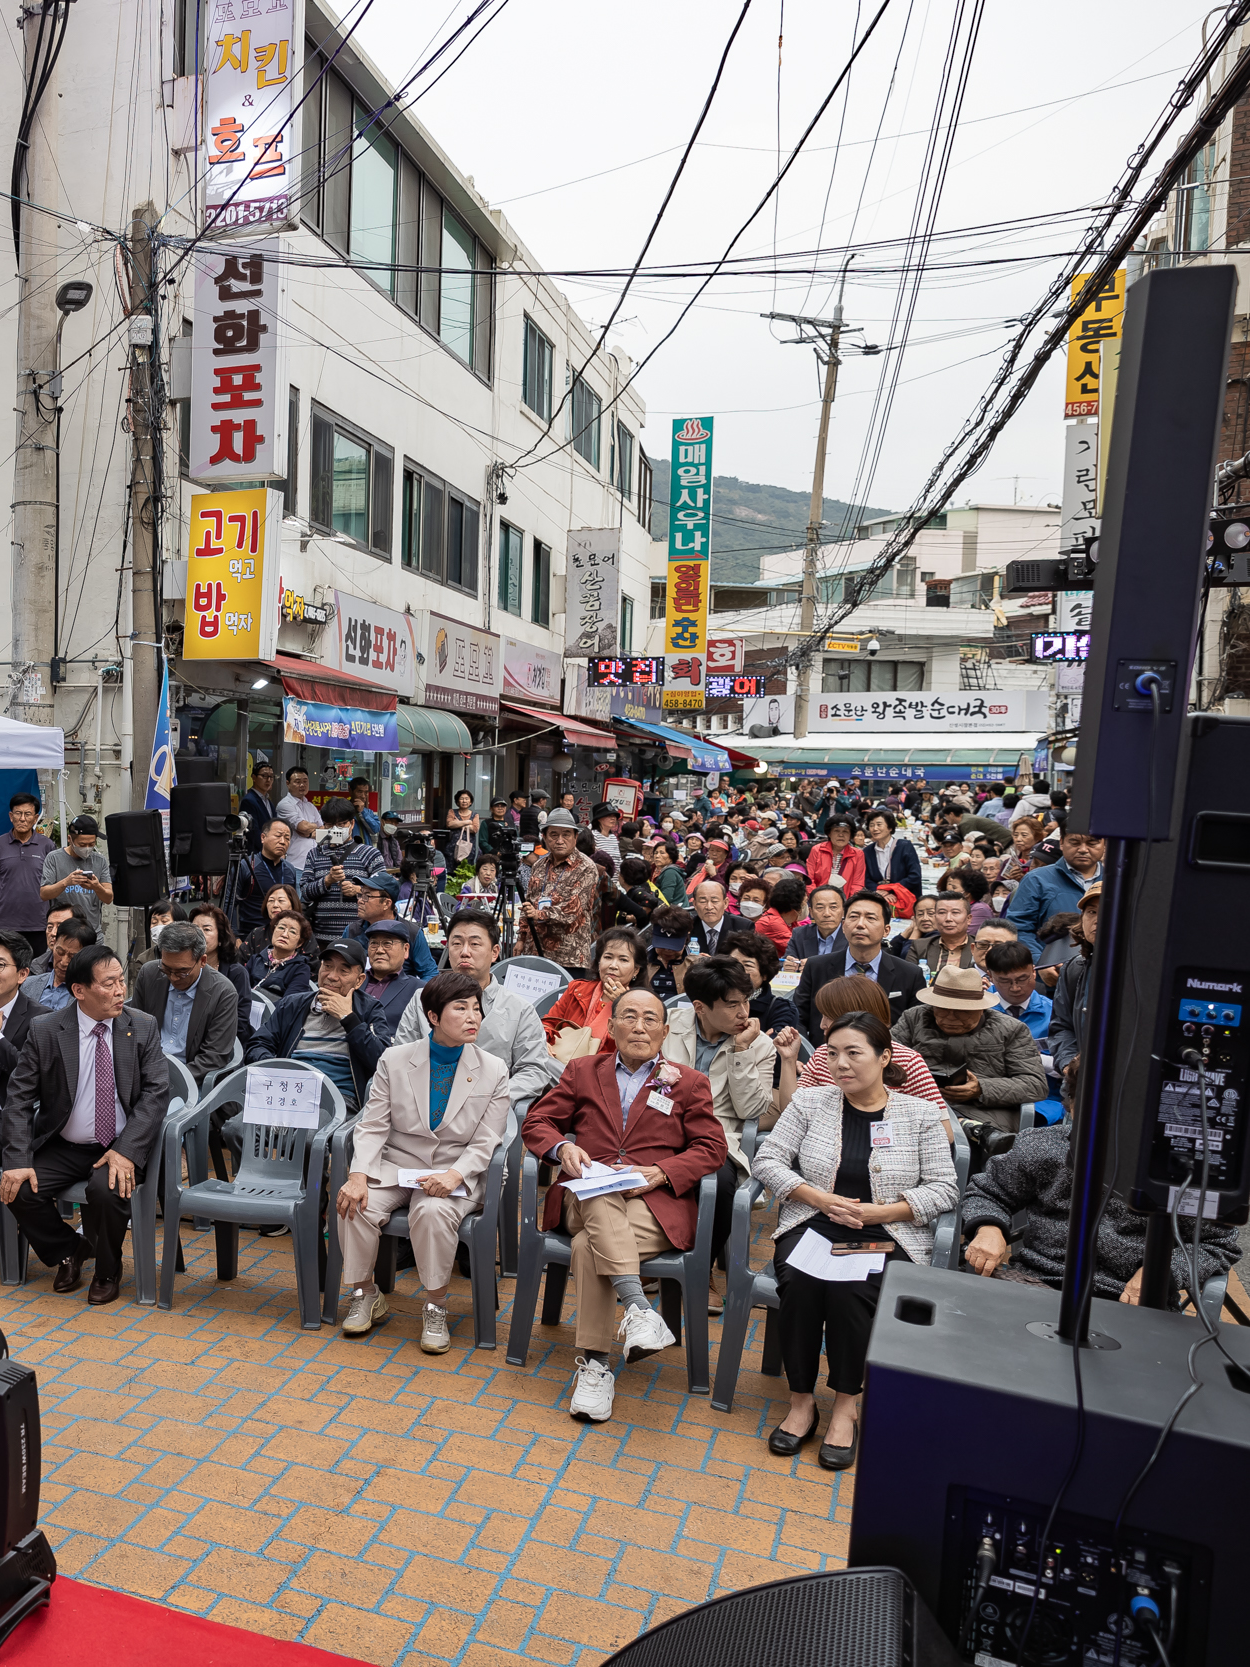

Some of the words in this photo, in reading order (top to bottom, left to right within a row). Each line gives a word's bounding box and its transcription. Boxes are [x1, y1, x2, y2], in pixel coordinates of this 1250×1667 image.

[212, 30, 289, 90] 치킨
[242, 94, 254, 107] &
[208, 116, 286, 180] 호프
[210, 253, 268, 466] 선화포차
[1066, 402, 1098, 416] 456-7
[674, 444, 709, 551] 매일사우나
[194, 508, 260, 558] 고기
[228, 558, 256, 583] 먹고
[284, 588, 304, 622] 먹자
[673, 564, 702, 614] 영일만
[193, 581, 228, 639] 밥
[224, 611, 253, 636] 먹자
[579, 569, 605, 653] 산꼼장어
[344, 616, 398, 673] 선화포차
[670, 616, 700, 649] 수산
[828, 641, 846, 649] CCTV
[670, 657, 702, 686] 회
[707, 640, 742, 672] 회
[664, 698, 702, 708] 458-8470
[830, 702, 868, 718] 소문난
[1186, 978, 1242, 992] Numark
[1180, 1069, 1226, 1086] LIGHWAVE
